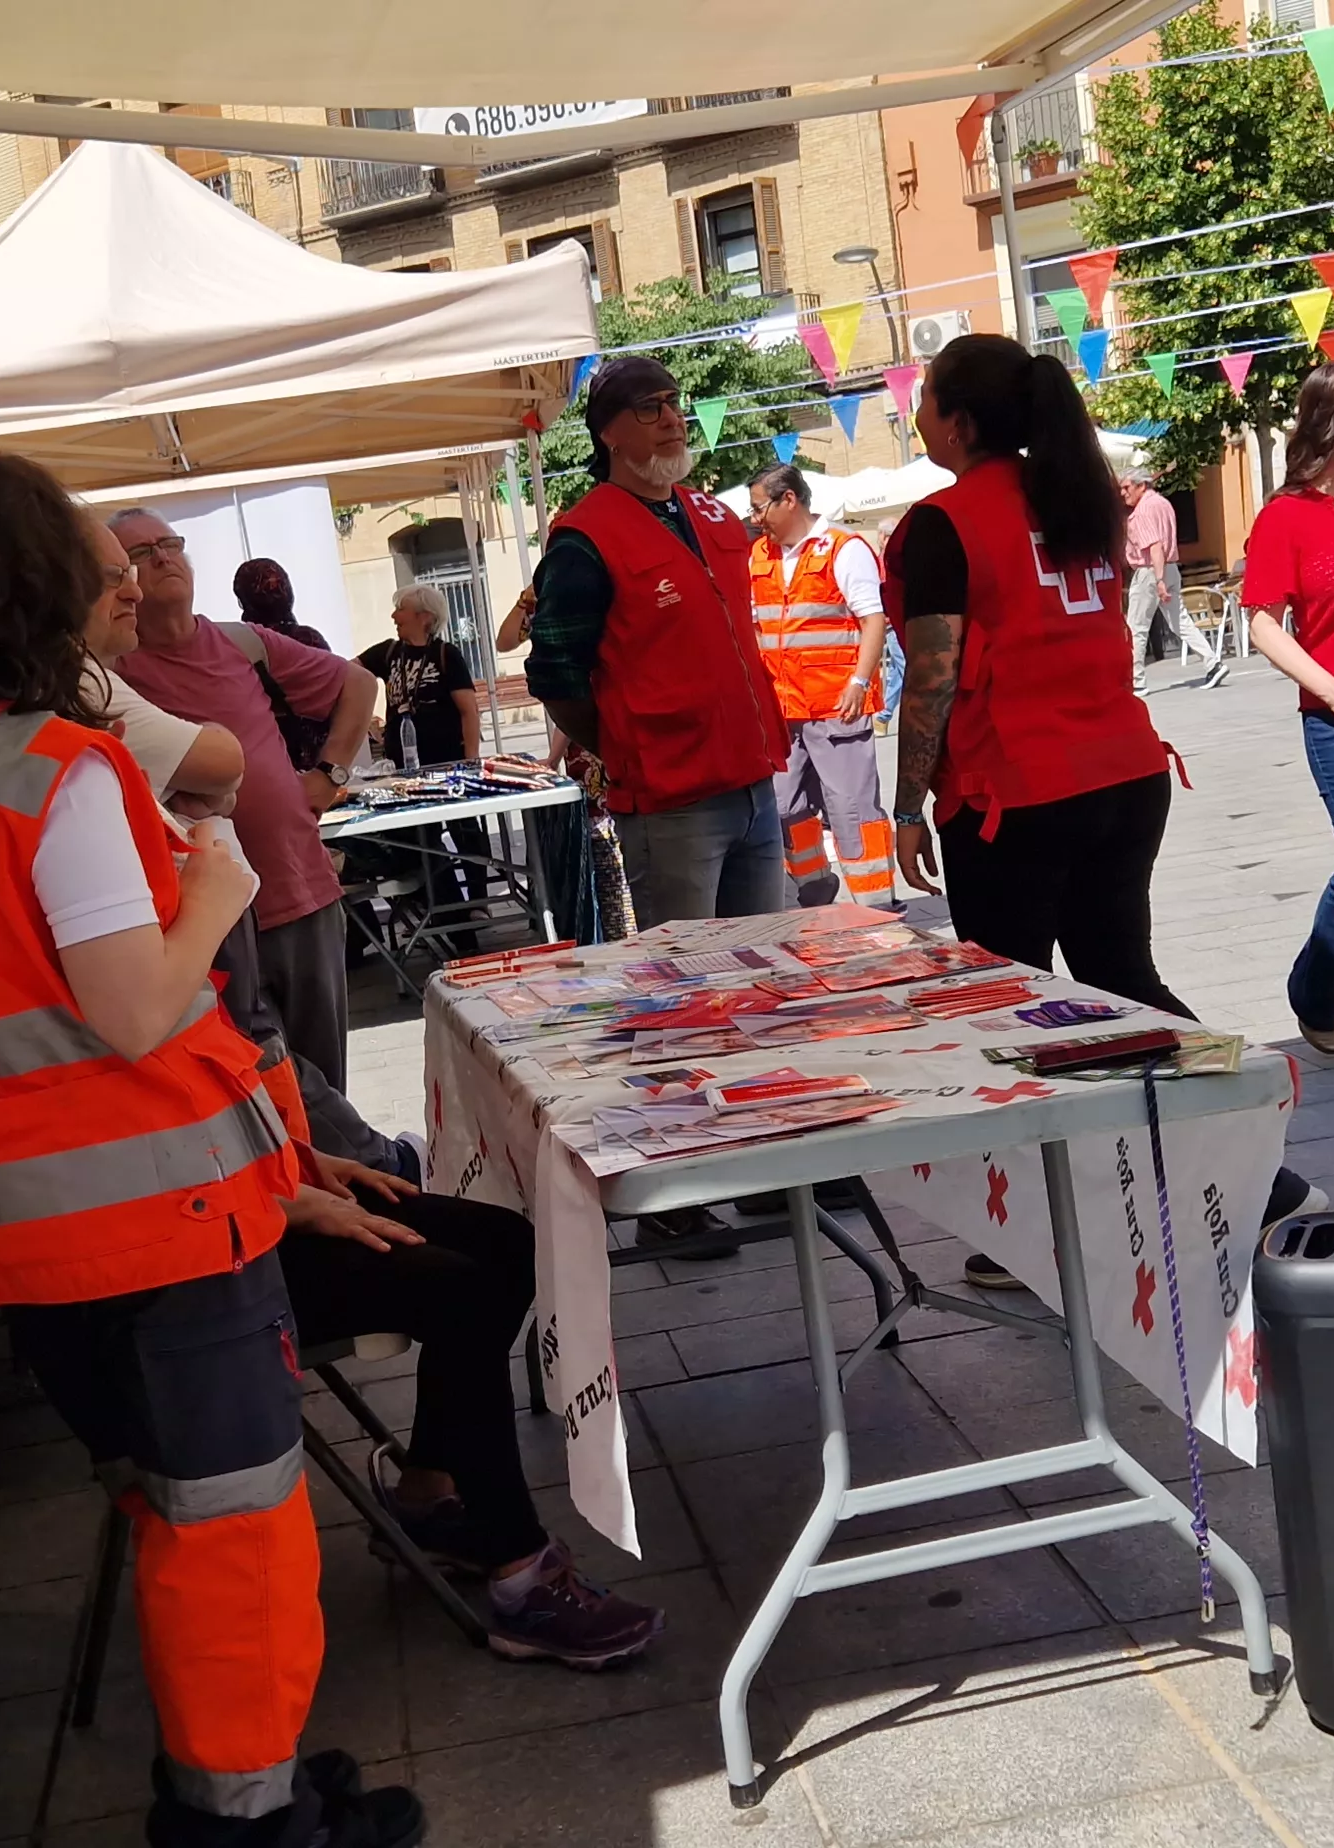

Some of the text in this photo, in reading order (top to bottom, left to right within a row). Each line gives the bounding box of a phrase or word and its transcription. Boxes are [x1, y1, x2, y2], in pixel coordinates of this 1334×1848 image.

[493, 349, 560, 367] MASTERTENT
[437, 444, 484, 456] MASTERTENT
[859, 495, 887, 508] AMBAR
[575, 1365, 613, 1420] Cruz
